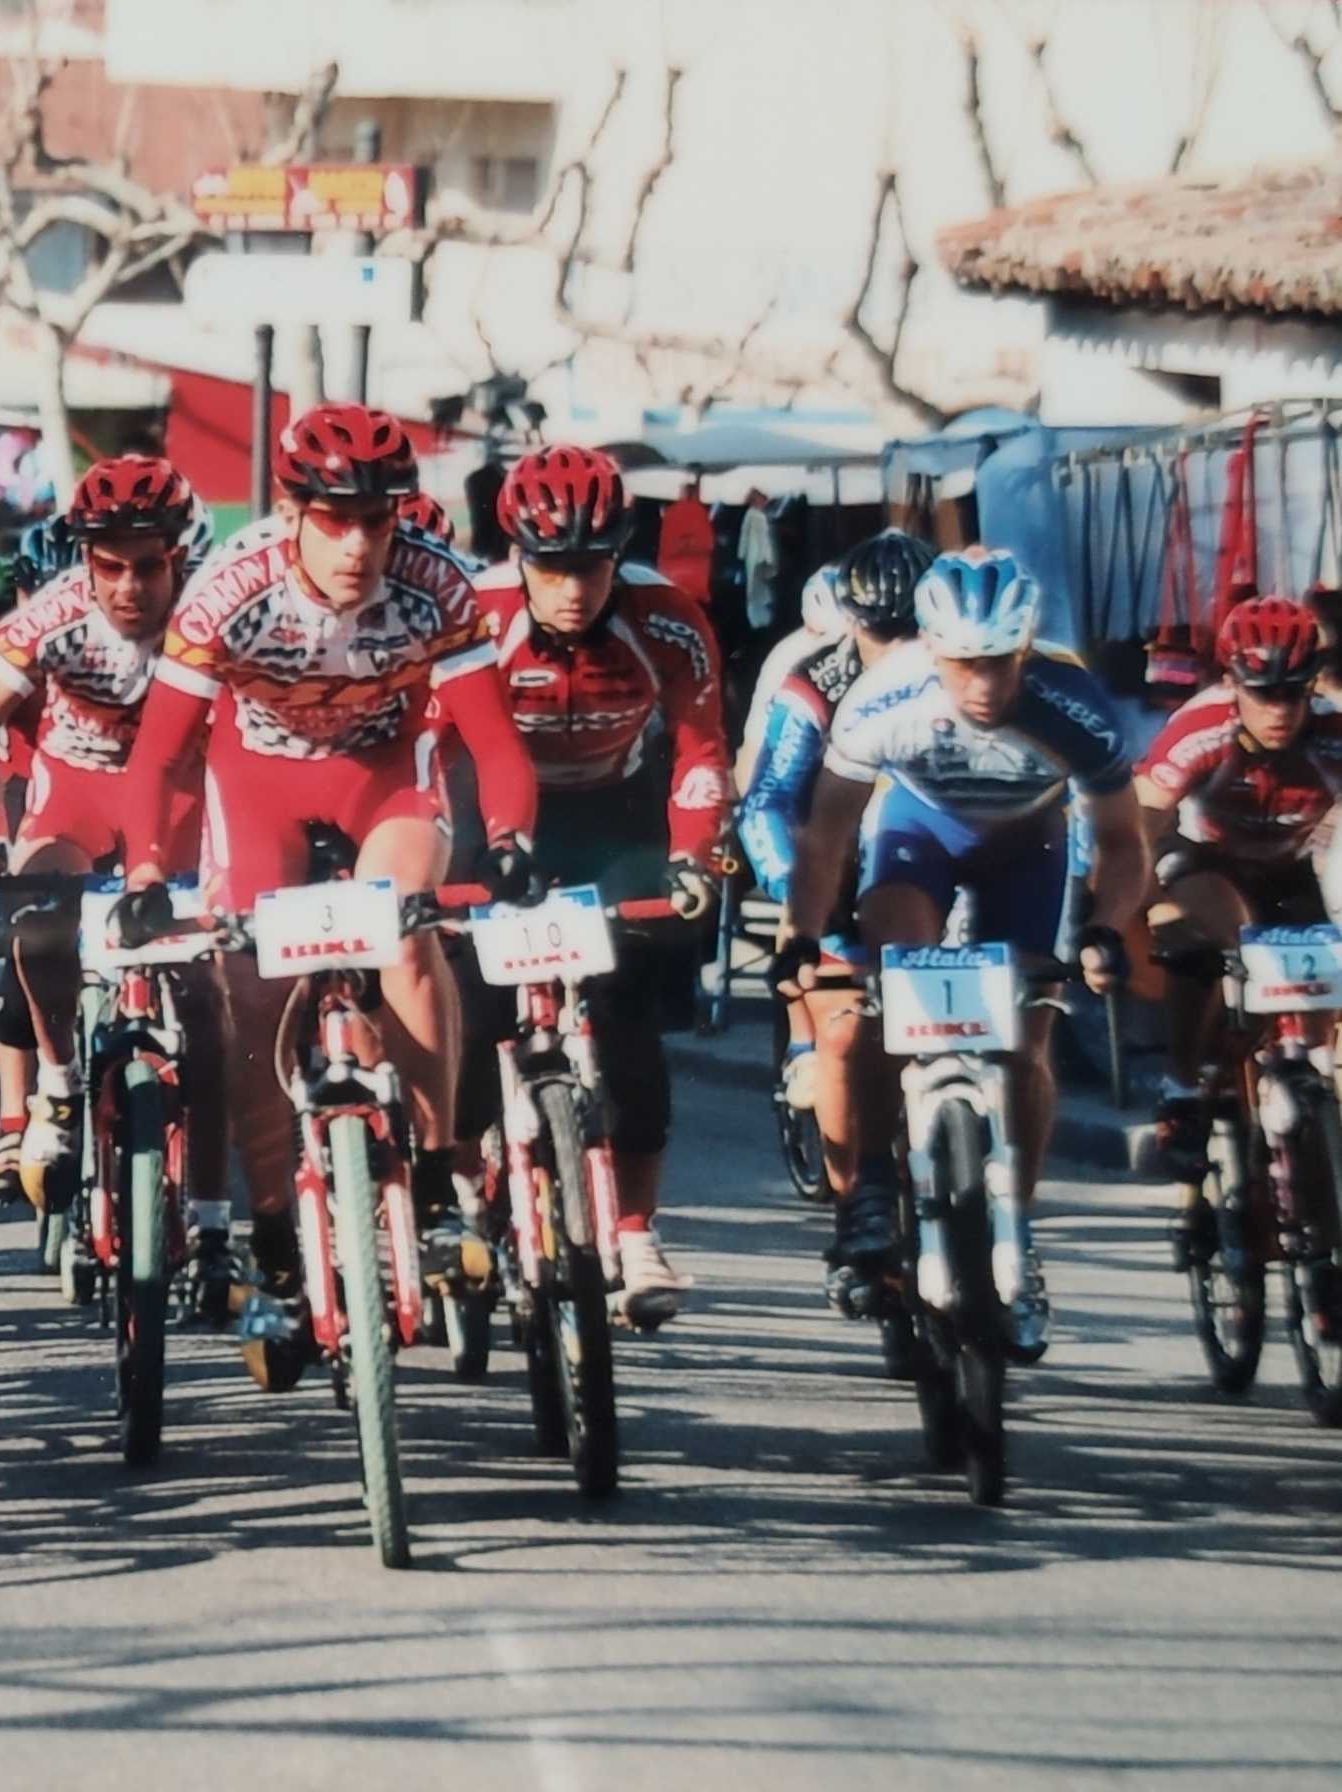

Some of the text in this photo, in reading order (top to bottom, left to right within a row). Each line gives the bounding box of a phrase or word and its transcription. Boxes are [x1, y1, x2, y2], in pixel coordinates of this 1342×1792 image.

[321, 904, 335, 933] 3
[522, 922, 563, 952] 10
[1281, 953, 1318, 981] 12
[942, 979, 954, 1016] 1
